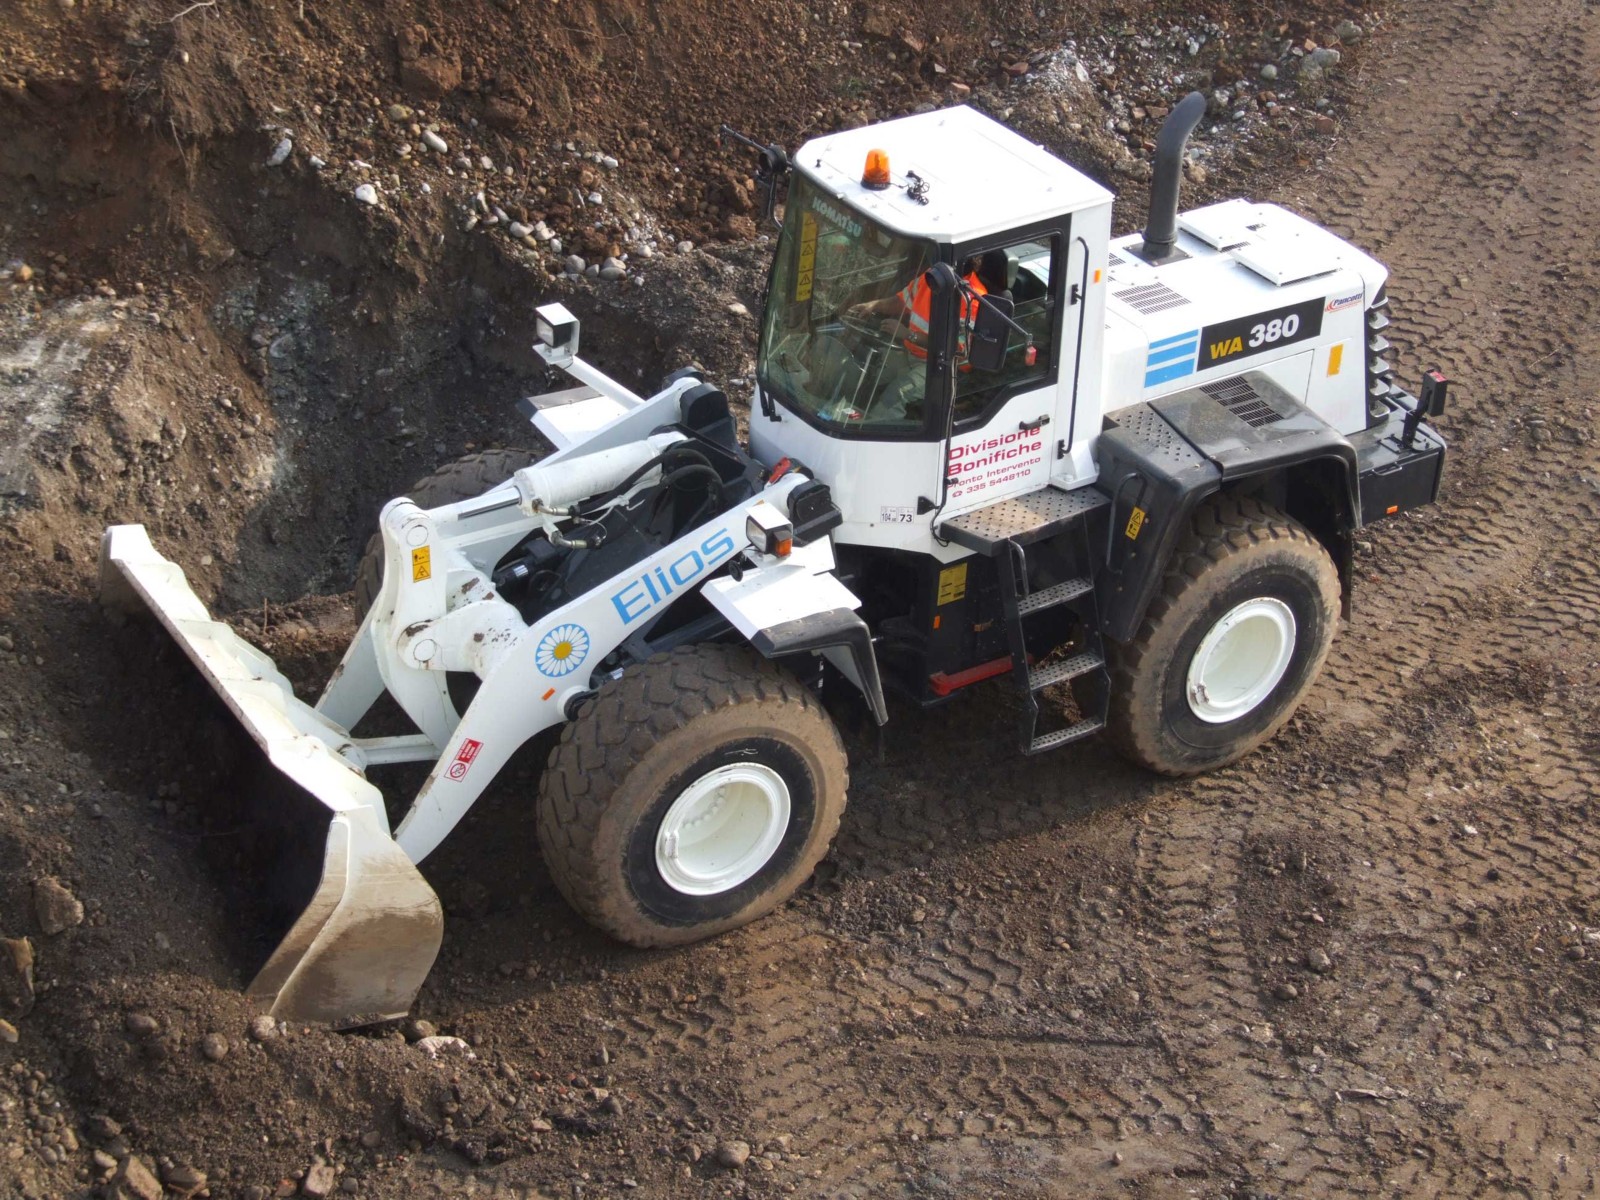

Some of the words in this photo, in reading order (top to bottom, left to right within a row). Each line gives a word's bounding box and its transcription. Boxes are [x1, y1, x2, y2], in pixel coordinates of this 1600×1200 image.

[812, 196, 862, 238] KOMATSU
[1210, 336, 1243, 360] WA
[1248, 313, 1300, 348] 380
[947, 441, 1042, 476] Bonifiche
[948, 426, 1041, 460] Divisione
[966, 482, 986, 494] 335
[989, 468, 1031, 487] 5448110
[987, 457, 1041, 478] Intervento
[899, 513, 912, 522] 73
[610, 527, 735, 625] Elios
